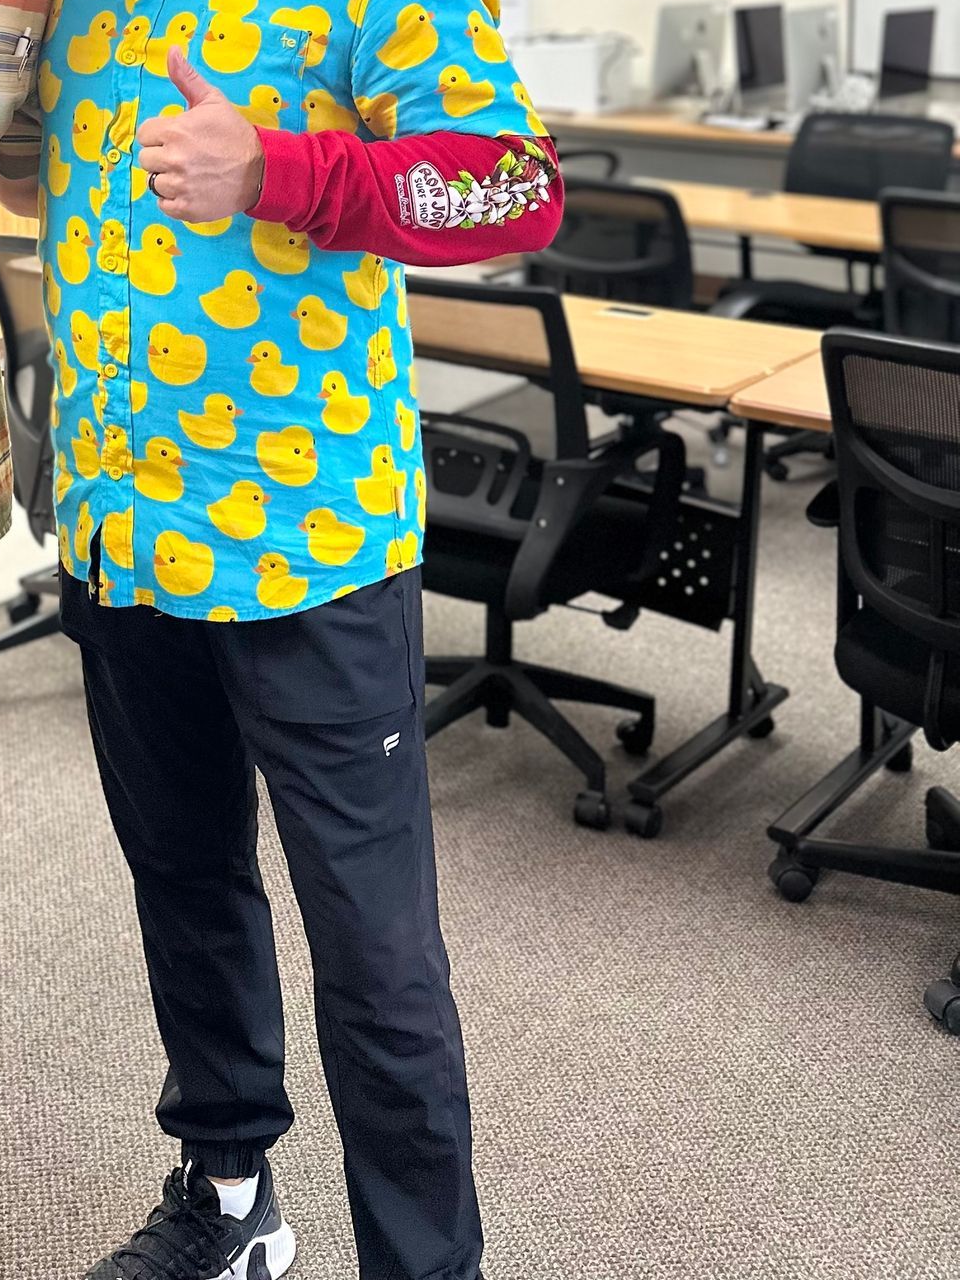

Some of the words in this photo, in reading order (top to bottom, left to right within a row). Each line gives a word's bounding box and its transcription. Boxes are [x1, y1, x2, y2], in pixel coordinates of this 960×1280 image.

[414, 177, 427, 199] SURF
[418, 167, 445, 198] RON
[419, 202, 429, 224] SHOP
[428, 201, 446, 228] JON
